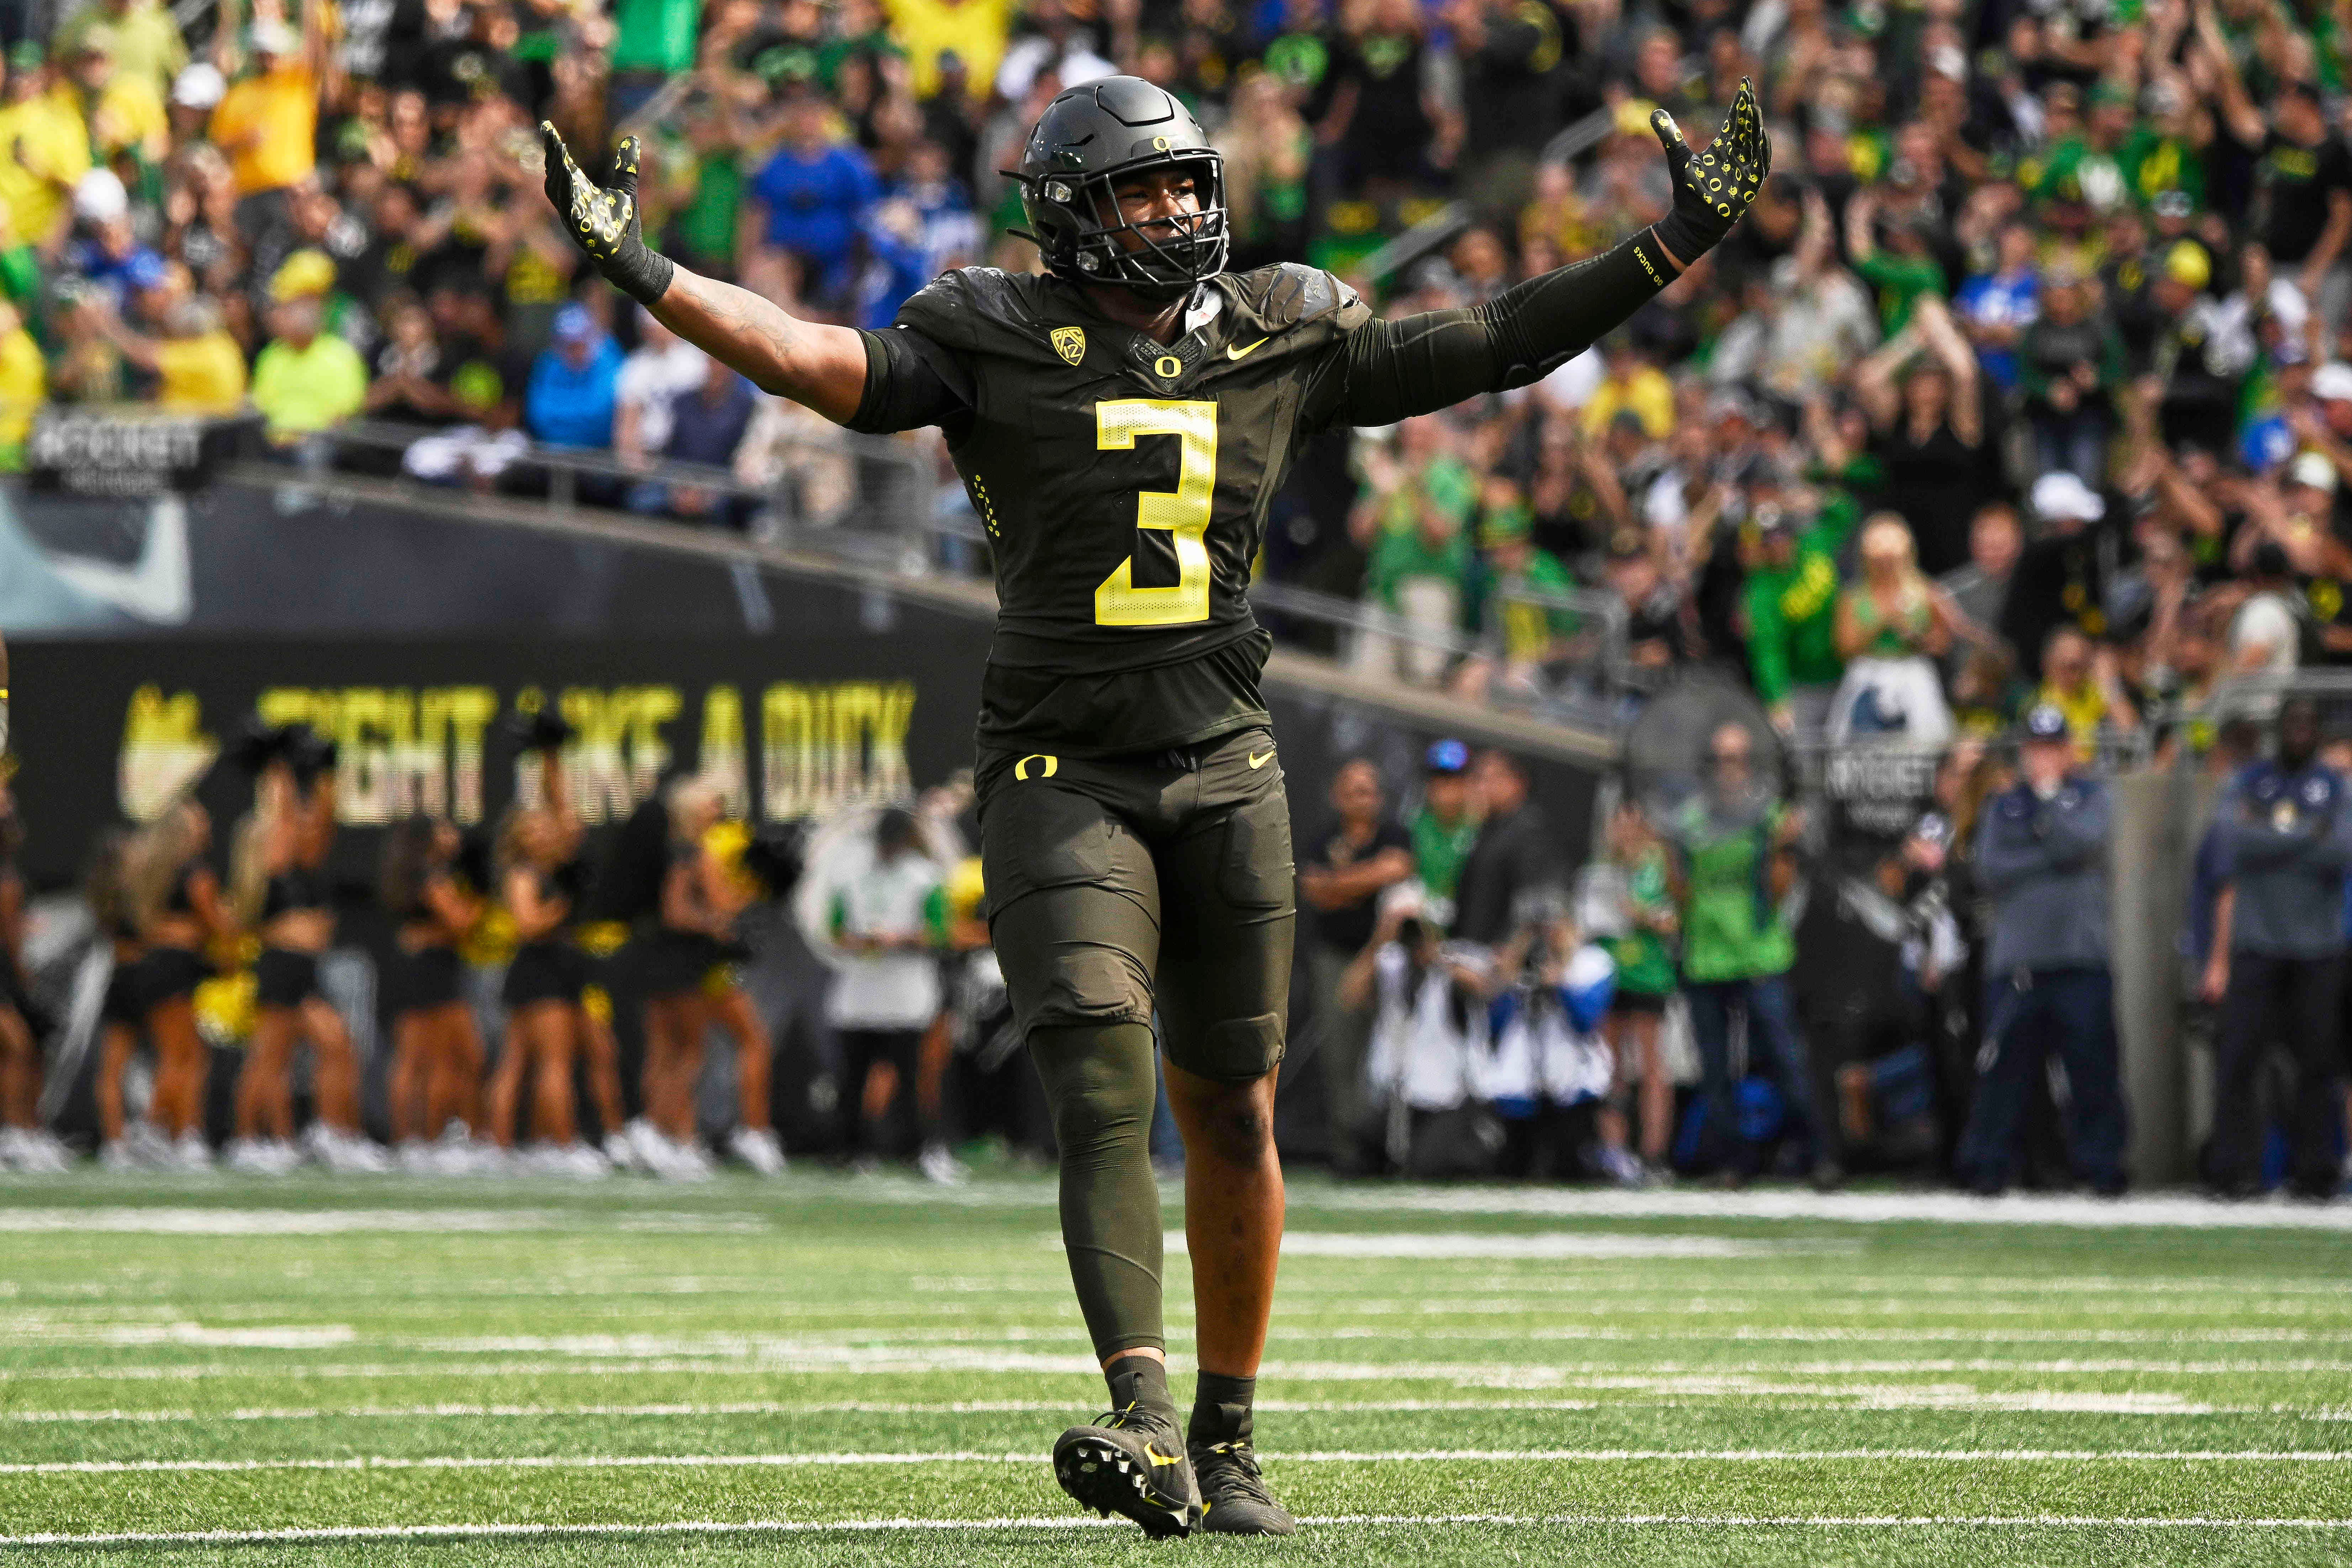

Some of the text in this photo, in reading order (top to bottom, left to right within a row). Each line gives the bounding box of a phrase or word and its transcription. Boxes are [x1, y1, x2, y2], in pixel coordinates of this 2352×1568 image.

[1153, 136, 1171, 152] O
[1634, 246, 1654, 275] DUCKS
[1053, 328, 1083, 352] PAC
[1063, 343, 1080, 359] 12
[1155, 356, 1181, 378] O
[1095, 400, 1218, 626] 3
[699, 684, 749, 822] A
